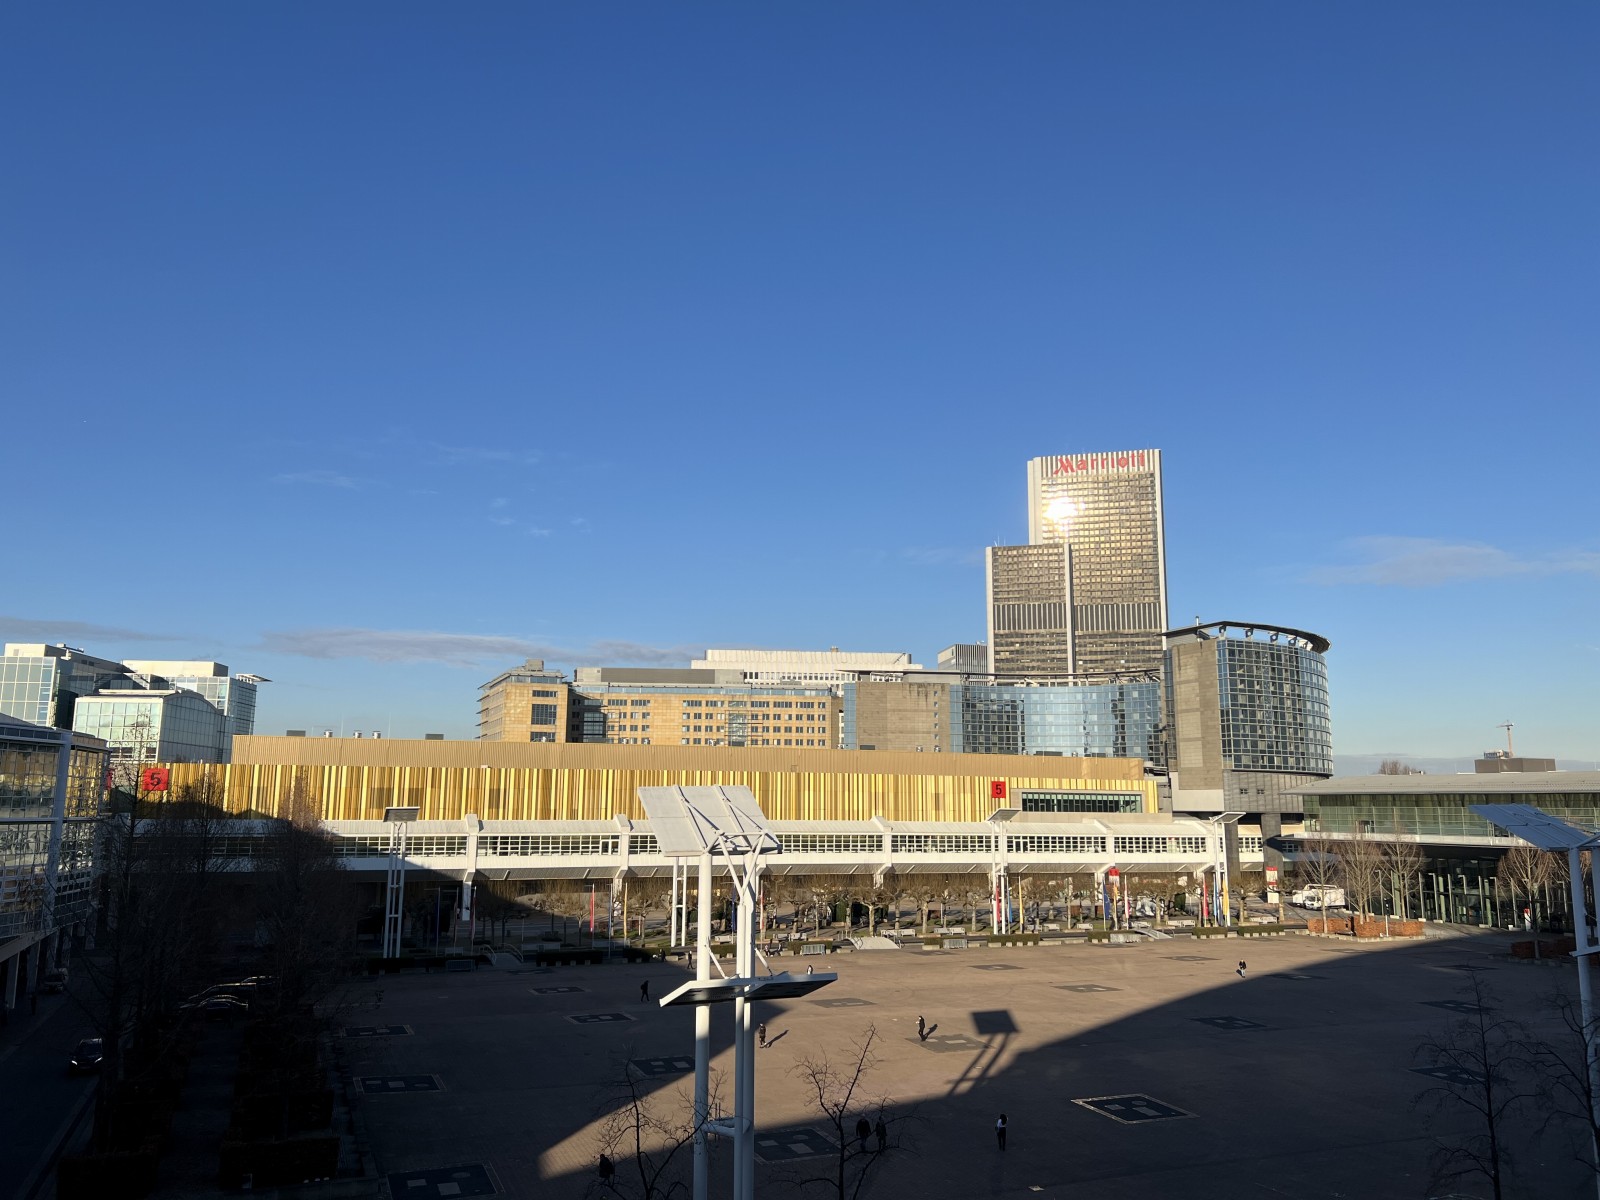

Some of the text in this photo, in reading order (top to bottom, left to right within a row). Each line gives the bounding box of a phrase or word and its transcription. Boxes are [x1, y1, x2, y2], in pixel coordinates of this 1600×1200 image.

[1053, 452, 1145, 474] Marriott
[150, 772, 161, 786] 5
[995, 783, 1003, 795] 5
